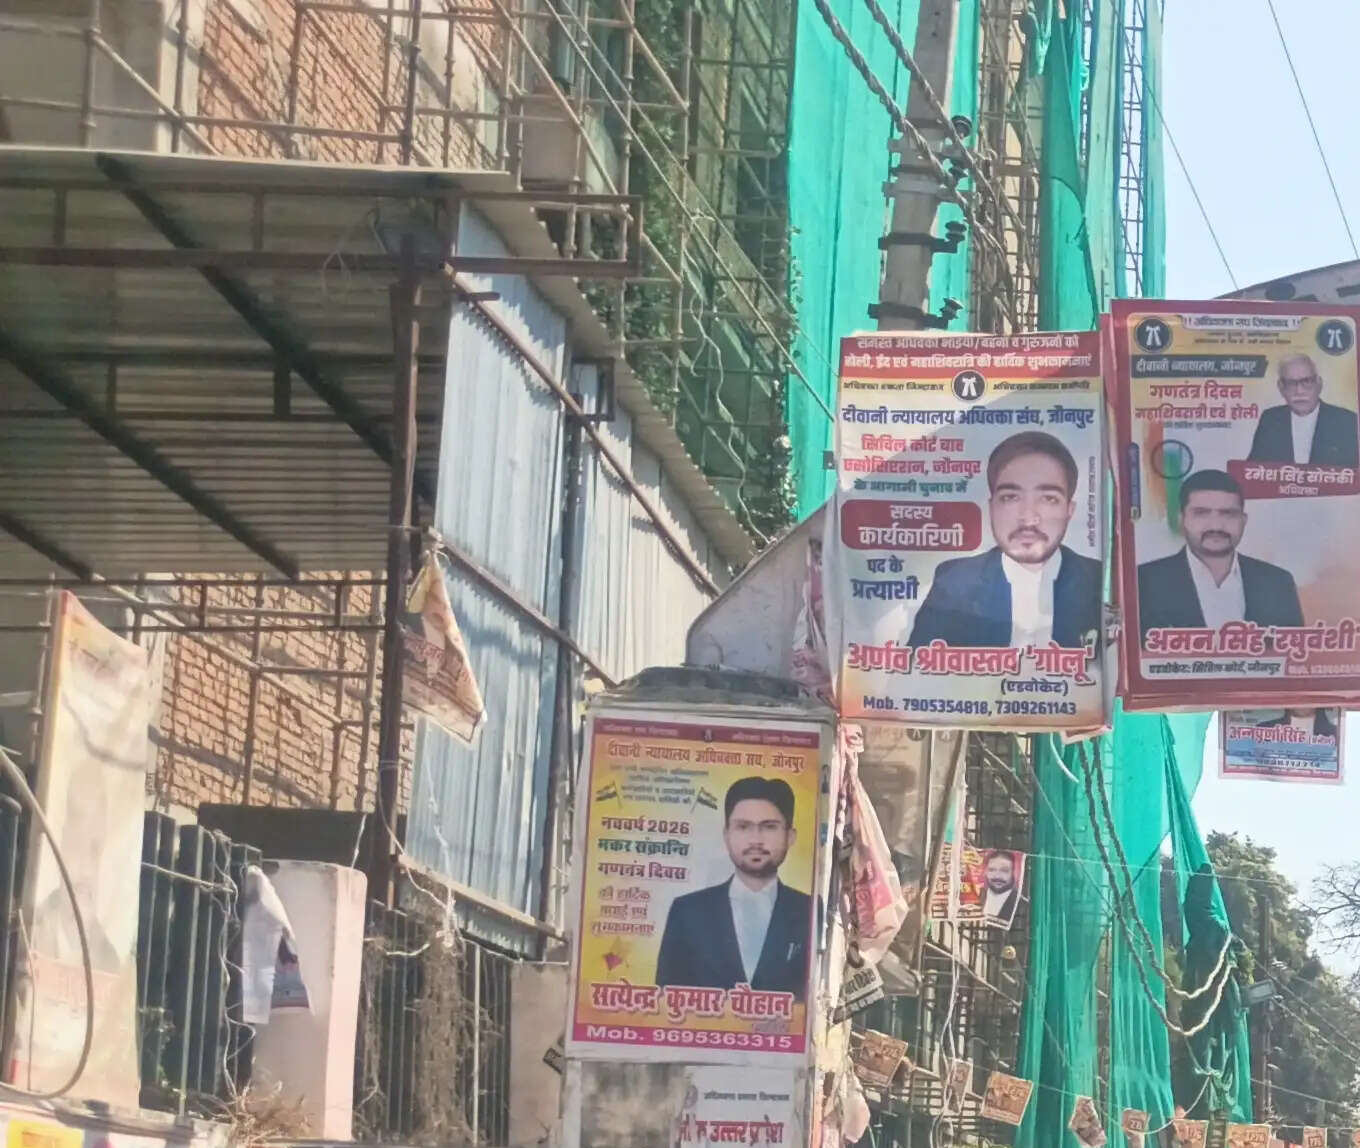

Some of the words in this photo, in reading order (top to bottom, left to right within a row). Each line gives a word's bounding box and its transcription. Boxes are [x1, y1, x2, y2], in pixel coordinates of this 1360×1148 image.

[843, 405, 887, 425] दीवानी
[891, 409, 954, 425] न्यायालय
[958, 406, 1013, 425] अधिवक्ता
[1047, 405, 1095, 429] जौनपुर
[1231, 404, 1259, 420] होली
[933, 457, 981, 479] जौनपुर
[890, 505, 933, 519] सदस्य
[858, 523, 964, 547] कार्यकारिणी
[867, 557, 886, 573] पद
[888, 554, 904, 573] के
[851, 575, 920, 601] प्रत्याशी
[1146, 628, 1215, 653] अमन
[1217, 620, 1265, 656] सिंह
[863, 695, 898, 711] Mob.
[995, 699, 1076, 716] 7309261143
[650, 820, 690, 835] 2026
[664, 985, 726, 1023] कुमार
[729, 983, 794, 1018] चौहान
[587, 1025, 644, 1041] Mob.
[653, 1029, 792, 1049] 9695363315
